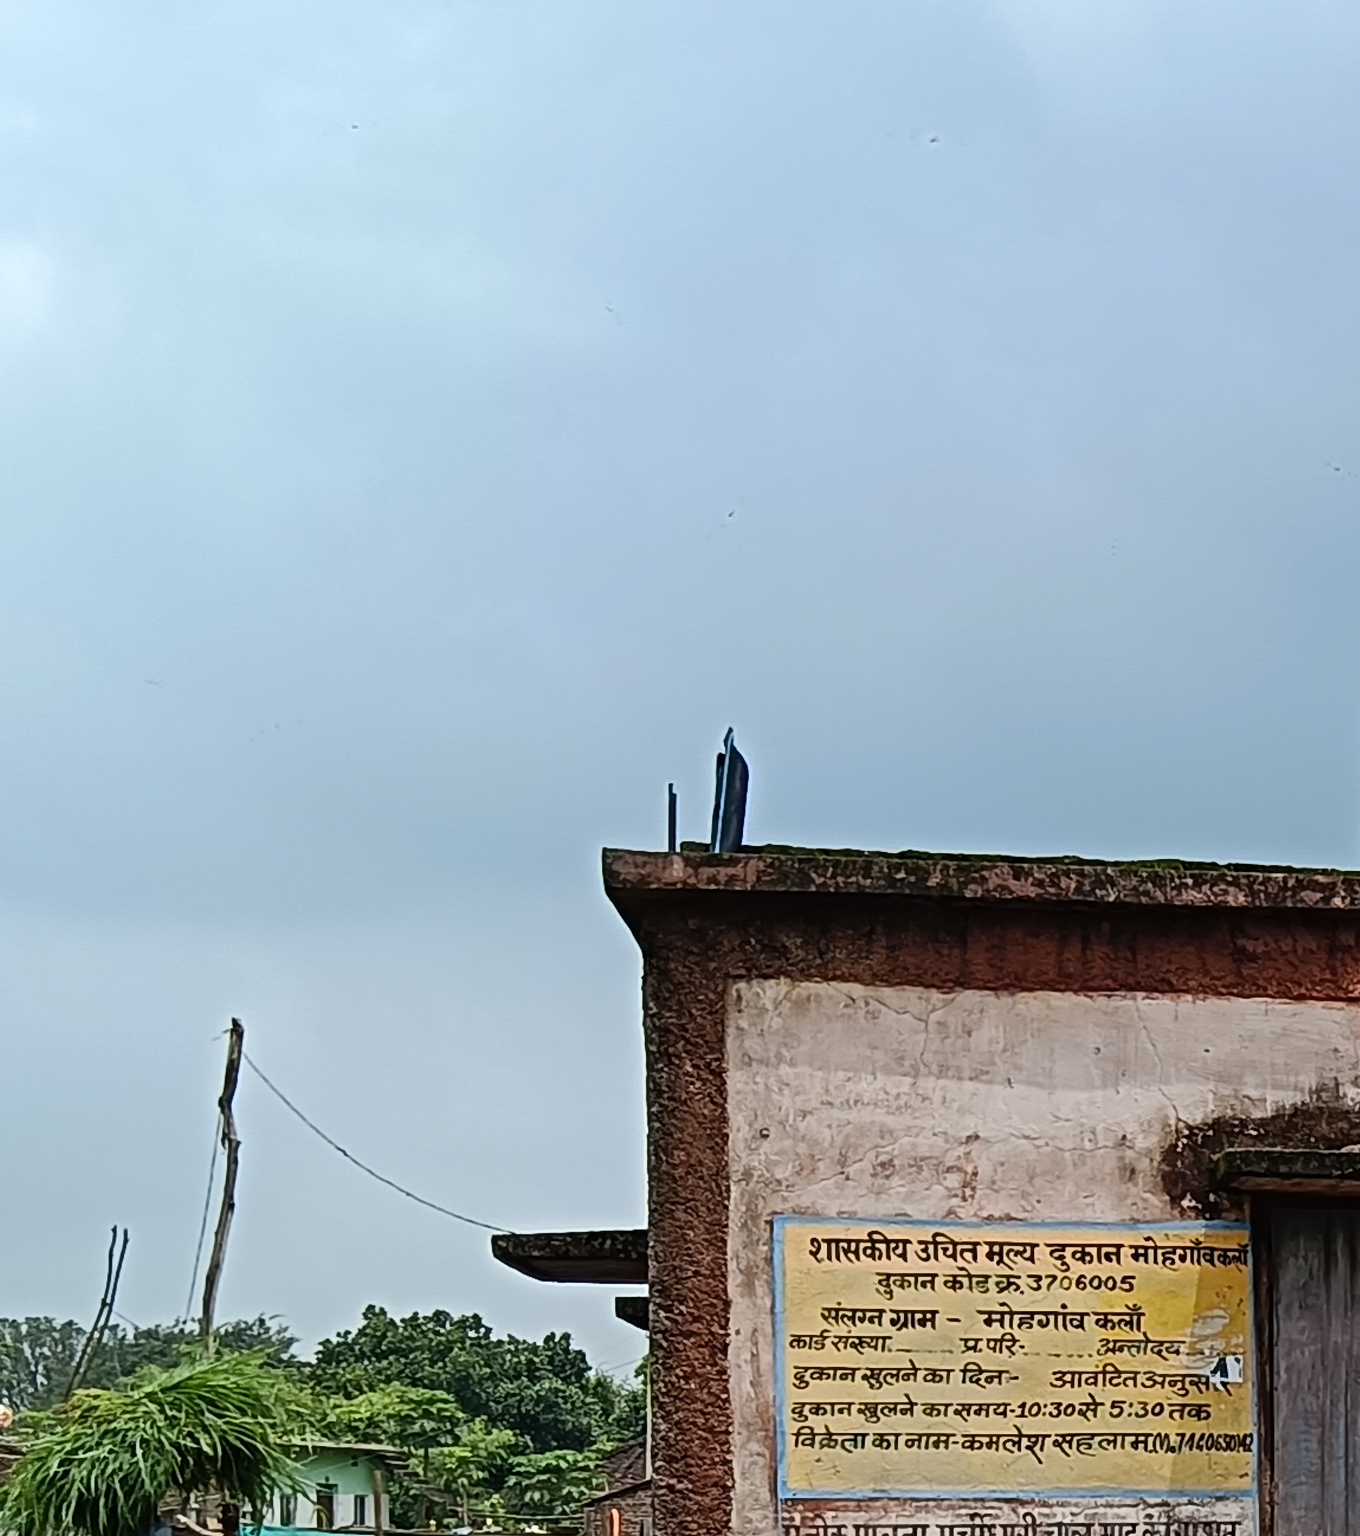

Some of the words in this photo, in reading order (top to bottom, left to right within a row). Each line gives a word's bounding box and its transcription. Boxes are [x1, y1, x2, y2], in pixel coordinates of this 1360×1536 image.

[809, 1231, 911, 1265] शासकीय
[915, 1232, 979, 1264] उचित
[984, 1239, 1039, 1271] मूल्य
[1045, 1240, 1125, 1273] दुकान
[875, 1272, 937, 1300] दुकान
[942, 1266, 992, 1294] कोड
[820, 1301, 887, 1330] संलग्न
[890, 1306, 939, 1332] ग्राम
[792, 1365, 861, 1390] दुकान
[860, 1358, 922, 1390] खुलने
[922, 1367, 956, 1385] का
[1049, 1362, 1139, 1390] आवंटित
[789, 1400, 852, 1424] दुकान
[856, 1393, 920, 1424] खुलने
[921, 1403, 953, 1421] का
[1109, 1402, 1164, 1419] 5:30
[1167, 1404, 1213, 1423] तक
[791, 1427, 868, 1452] विक्रेता
[870, 1432, 899, 1451] का
